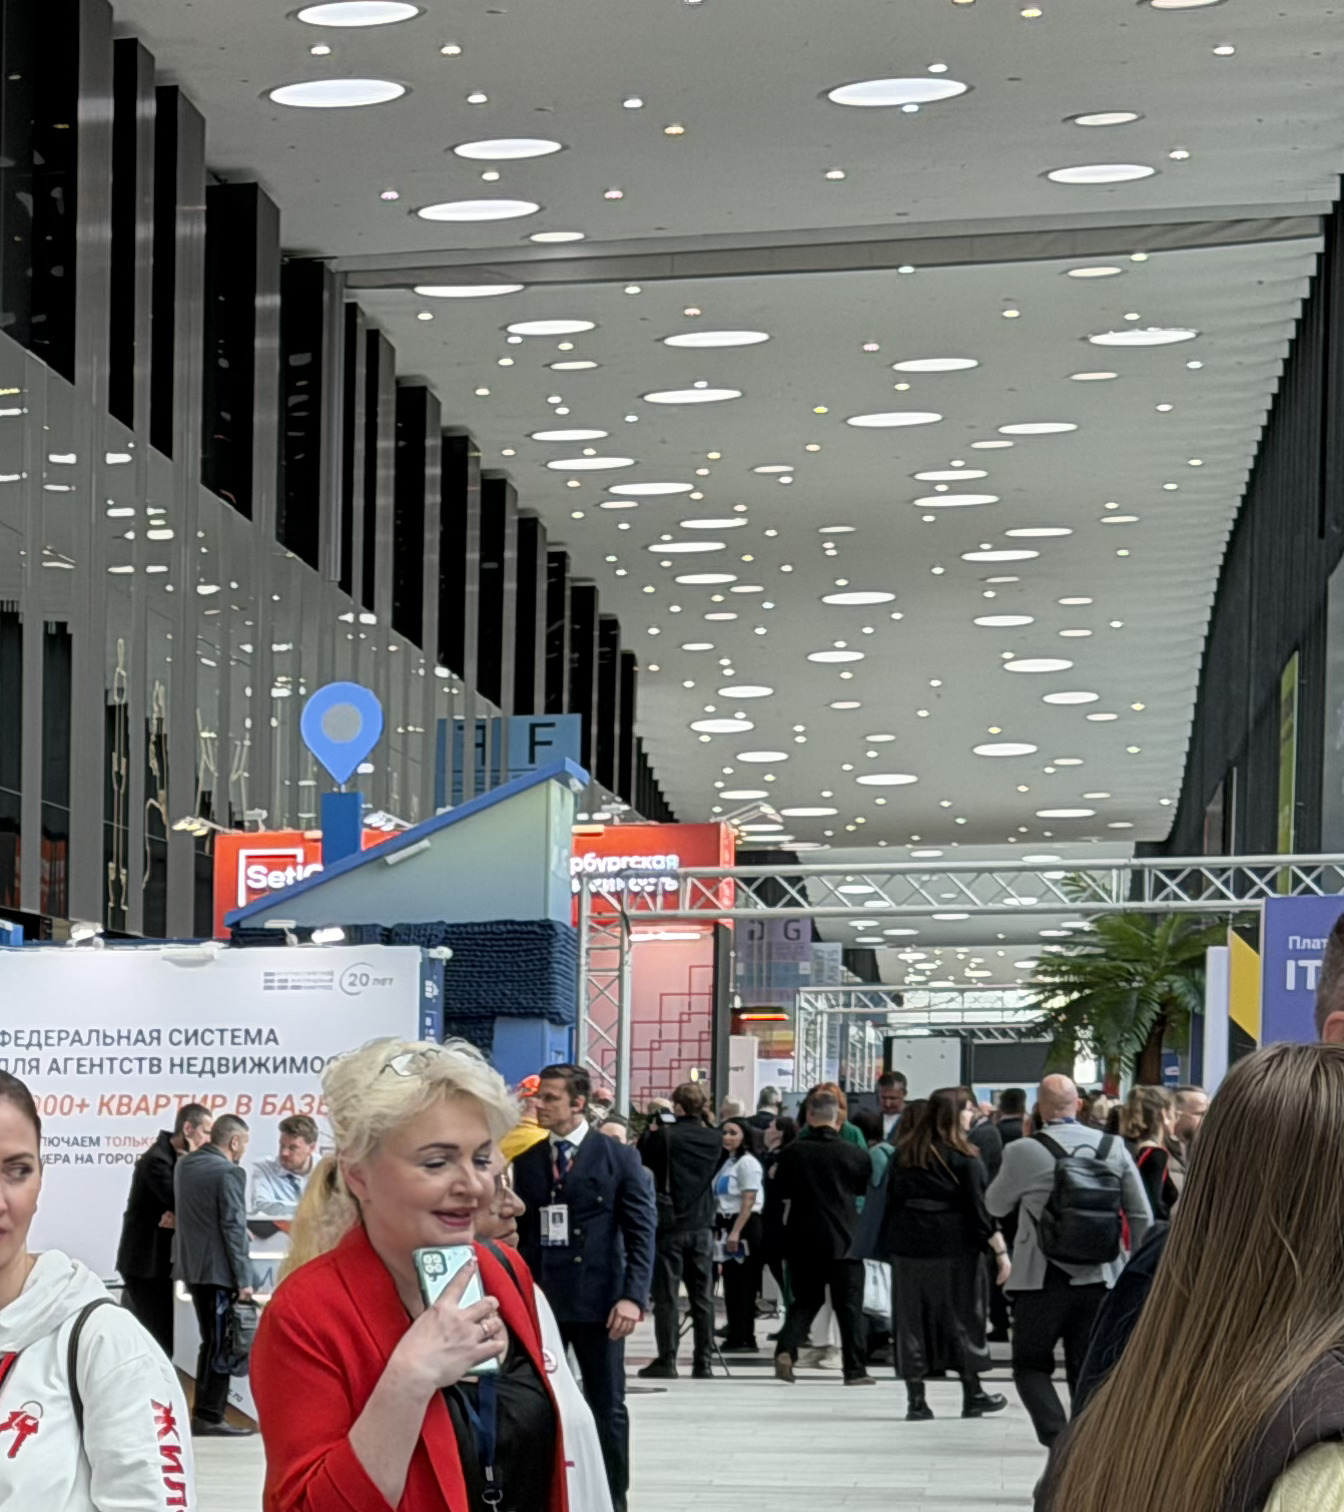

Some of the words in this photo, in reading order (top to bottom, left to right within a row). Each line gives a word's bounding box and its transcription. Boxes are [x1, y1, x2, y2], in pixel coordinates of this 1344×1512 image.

[529, 722, 556, 764] F
[784, 919, 801, 941] G
[168, 1028, 280, 1047] СИСТЕМА
[47, 1057, 162, 1075] АГЕНТСТВ
[98, 1094, 228, 1116] КВАРТИР
[236, 1094, 252, 1116] В
[75, 1153, 94, 1165] НА
